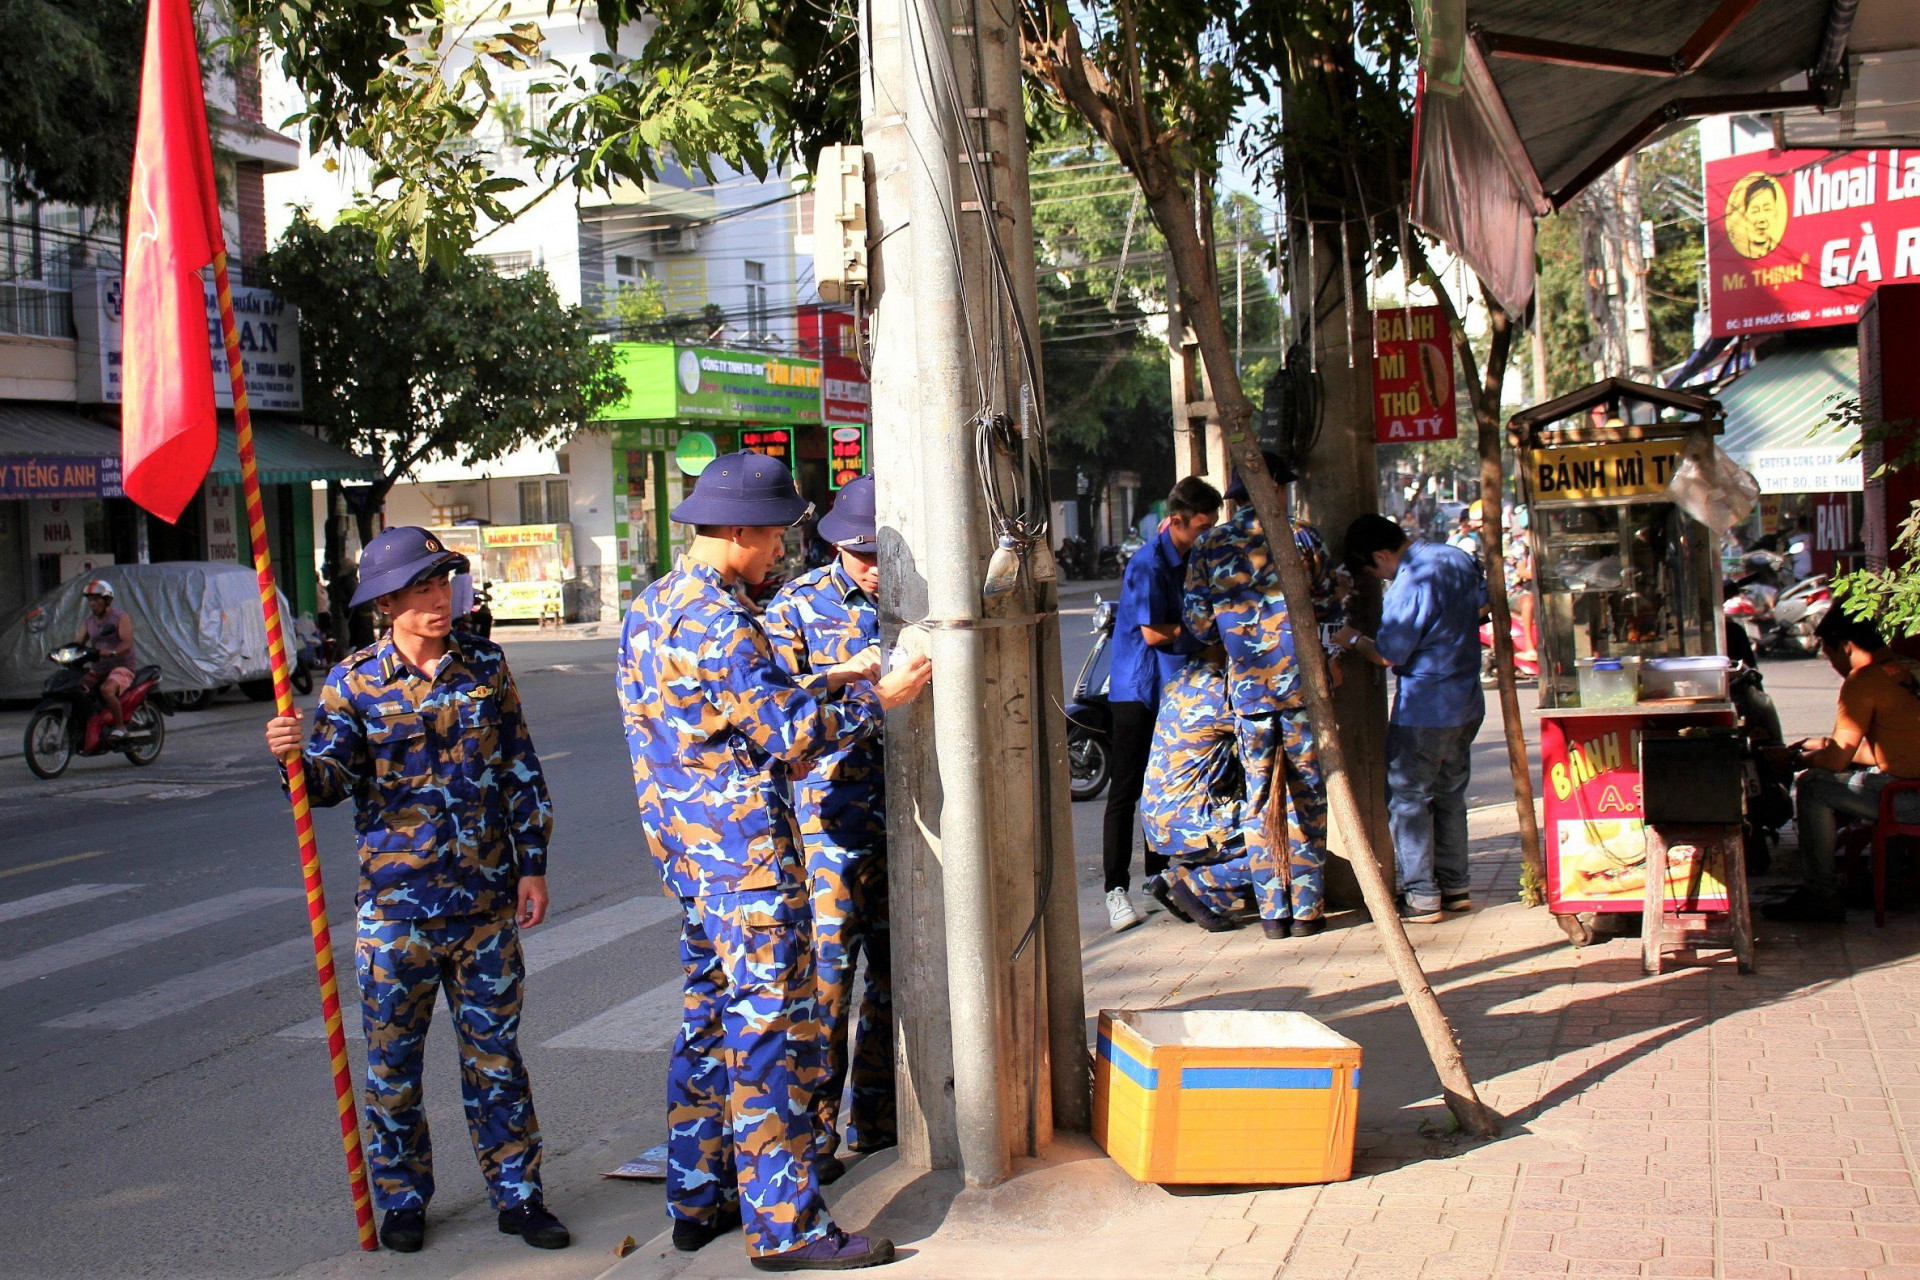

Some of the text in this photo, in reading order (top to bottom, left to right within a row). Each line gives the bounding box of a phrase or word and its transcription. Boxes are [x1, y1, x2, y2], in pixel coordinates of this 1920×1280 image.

[1793, 151, 1877, 217] Khoai
[1820, 221, 1882, 288] GÀ
[1722, 262, 1803, 292] Mr. THỊNH
[1378, 312, 1436, 343] BÁNH
[1787, 309, 1811, 323] LONG
[1380, 349, 1406, 380] MÌ
[1381, 381, 1421, 417] THỔ
[1389, 414, 1443, 438] A.TÝ
[12, 459, 60, 488] TIẾNG
[63, 465, 97, 487] ANH
[1539, 456, 1605, 492] BÁNH
[1615, 451, 1645, 486] MÌ
[44, 520, 72, 540] NHÀ
[213, 516, 232, 534] NHÀ
[210, 538, 236, 560] THUỐC
[1551, 732, 1621, 801] BÁNH
